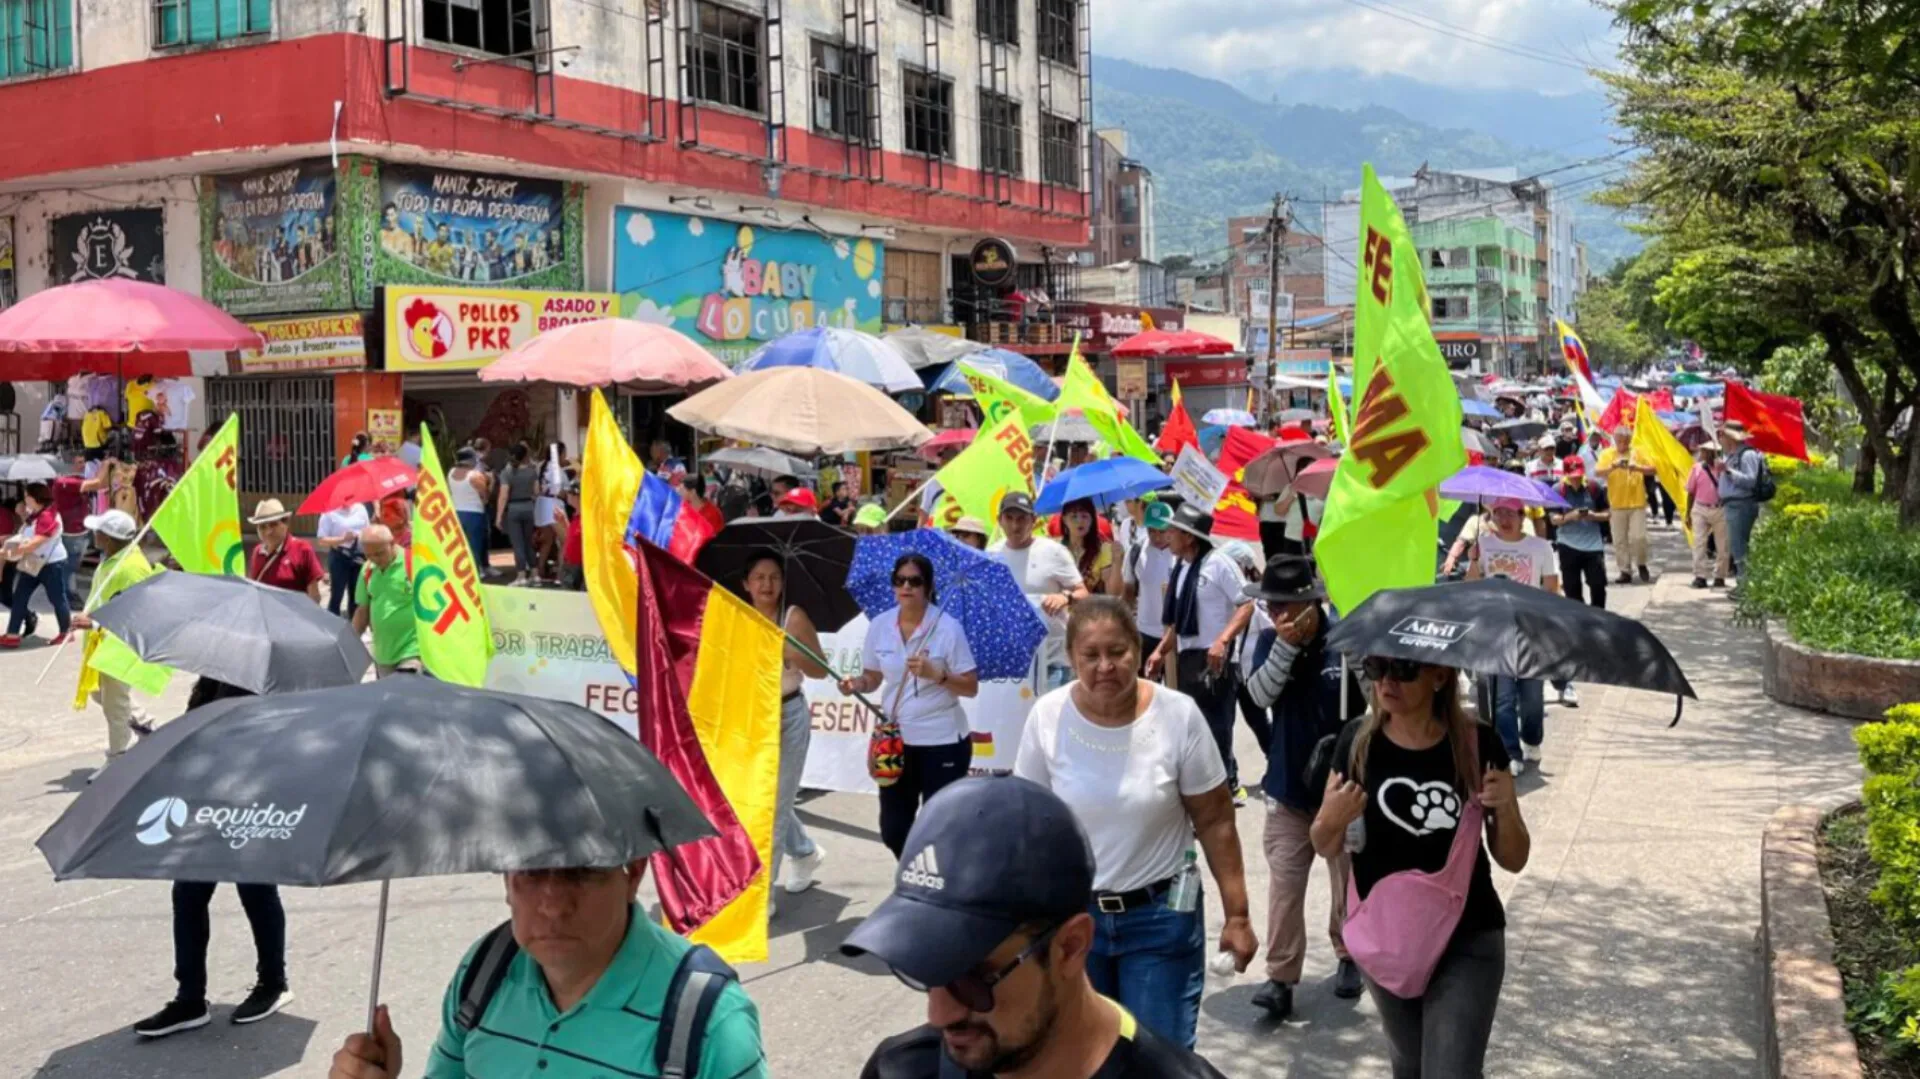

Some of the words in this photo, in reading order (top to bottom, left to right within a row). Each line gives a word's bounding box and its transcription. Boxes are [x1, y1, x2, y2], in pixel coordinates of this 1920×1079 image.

[432, 174, 469, 195] NANIX
[472, 177, 518, 198] SPORT
[396, 190, 430, 214] TODO
[433, 199, 448, 212] EN
[451, 201, 484, 217] ROPA
[488, 203, 550, 223] DEPORTIVA
[95, 244, 108, 268] E
[743, 258, 817, 298] BABY
[459, 303, 520, 323] POLLOS
[544, 298, 596, 313] ASADO
[600, 300, 610, 313] Y
[267, 321, 317, 341] POLLOS
[319, 317, 354, 338] PKR
[538, 317, 607, 331] BRO
[705, 302, 829, 335] LOCURA
[467, 327, 512, 350] PKR
[413, 564, 471, 636] GT
[1403, 620, 1457, 637] Advil
[531, 632, 618, 663] TRABA
[585, 684, 639, 713] FEG
[194, 802, 308, 830] equidad
[220, 824, 296, 850] seguros
[902, 870, 945, 890] adidas
